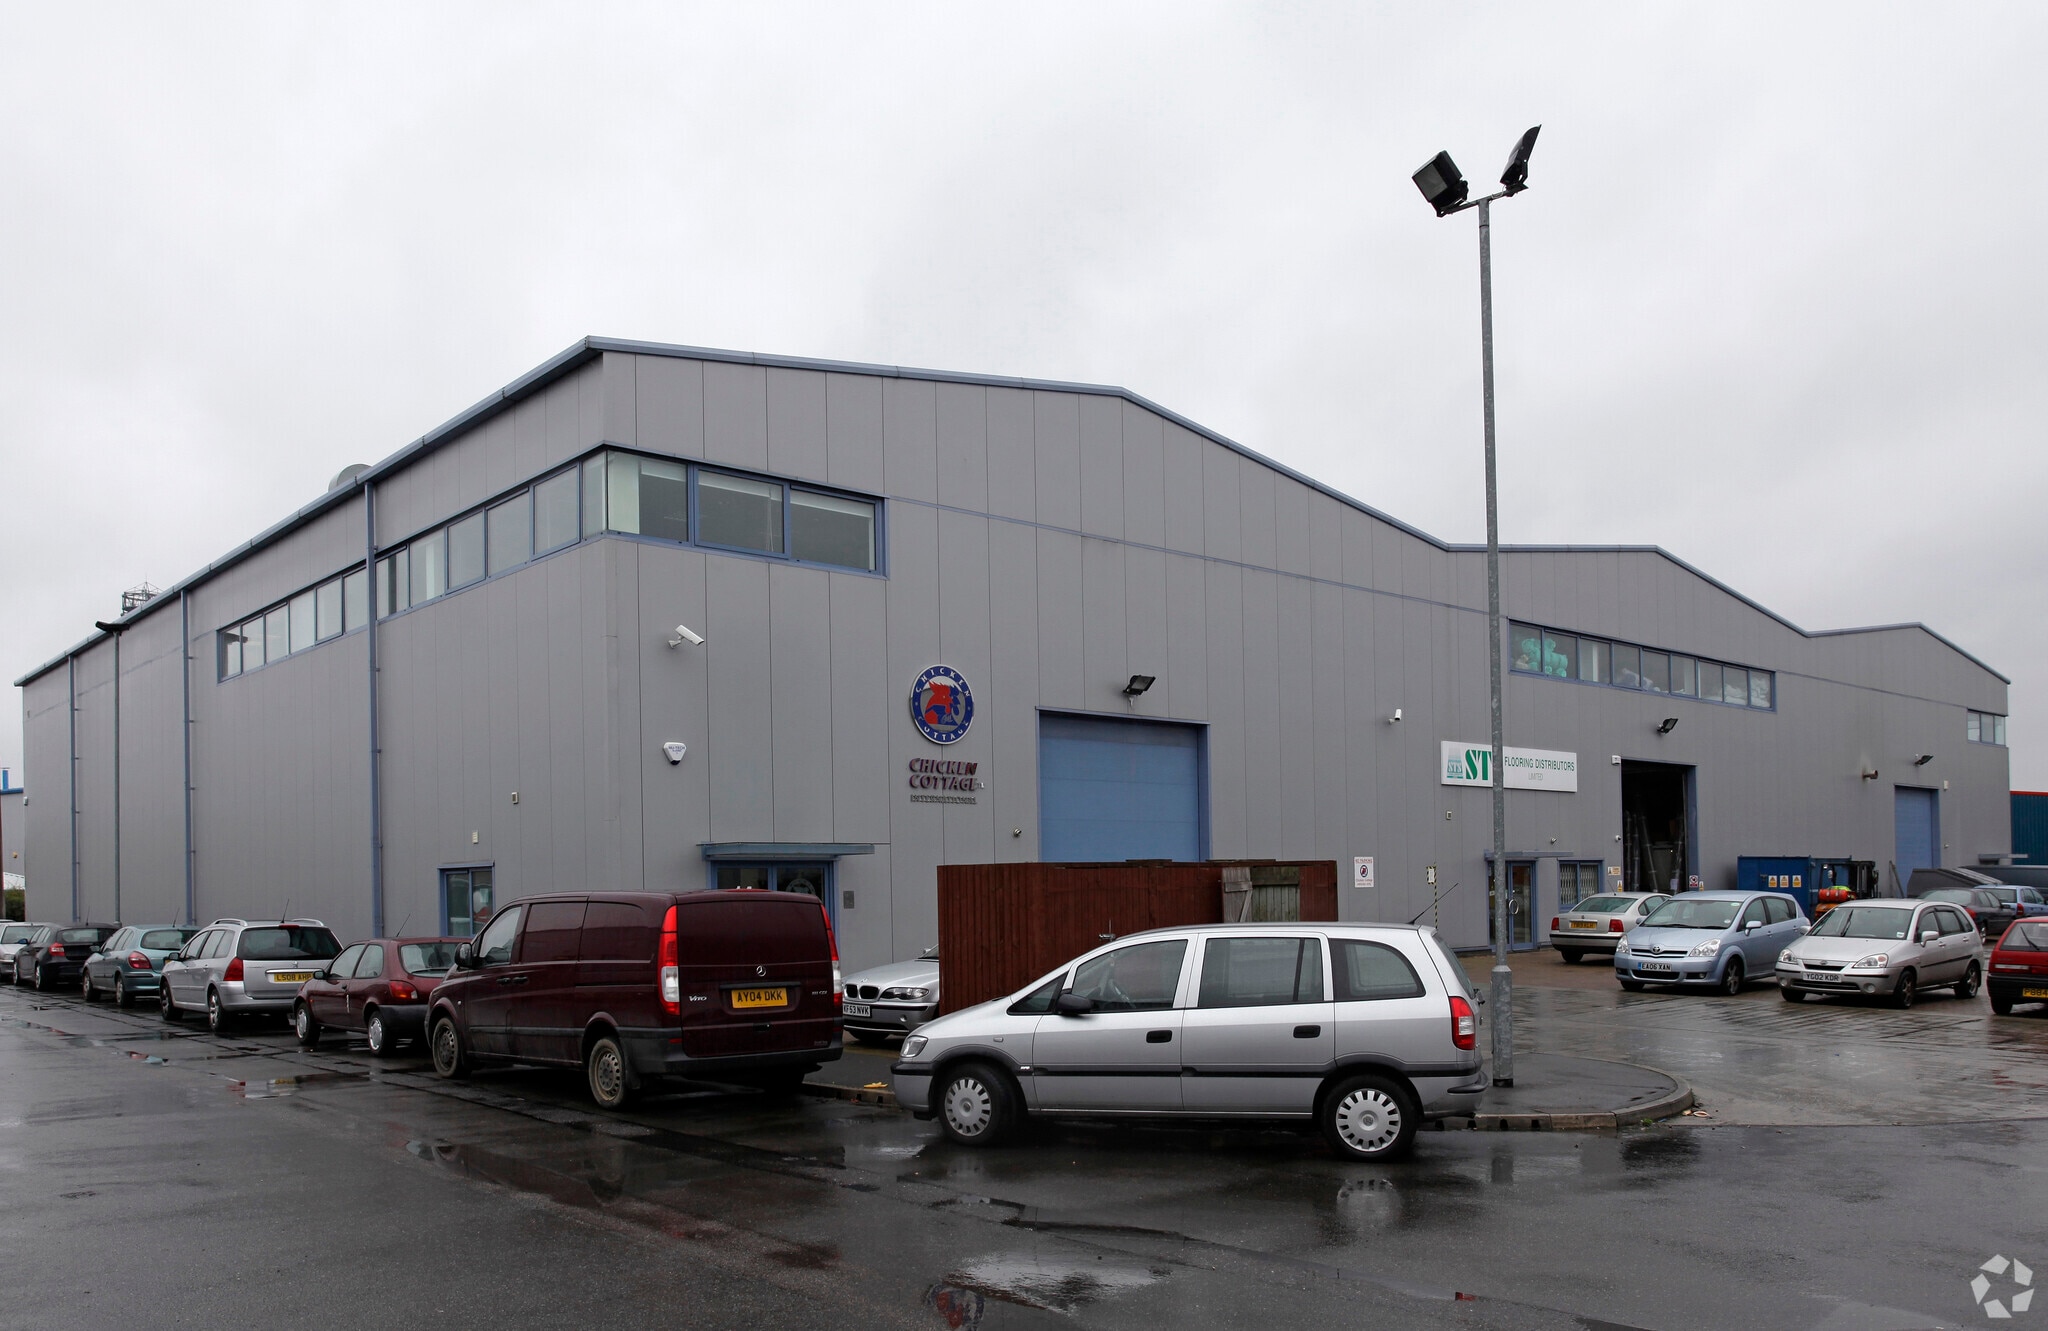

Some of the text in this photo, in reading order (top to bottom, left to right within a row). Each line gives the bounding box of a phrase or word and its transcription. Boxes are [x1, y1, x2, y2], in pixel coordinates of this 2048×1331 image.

[915, 667, 971, 697] CHICKEN
[909, 757, 978, 776] CHICKEN
[1504, 756, 1575, 772] FLOORING DISTRIBUTORS
[909, 774, 978, 792] COTTAGE
[737, 990, 783, 1003] AY04 DKK
